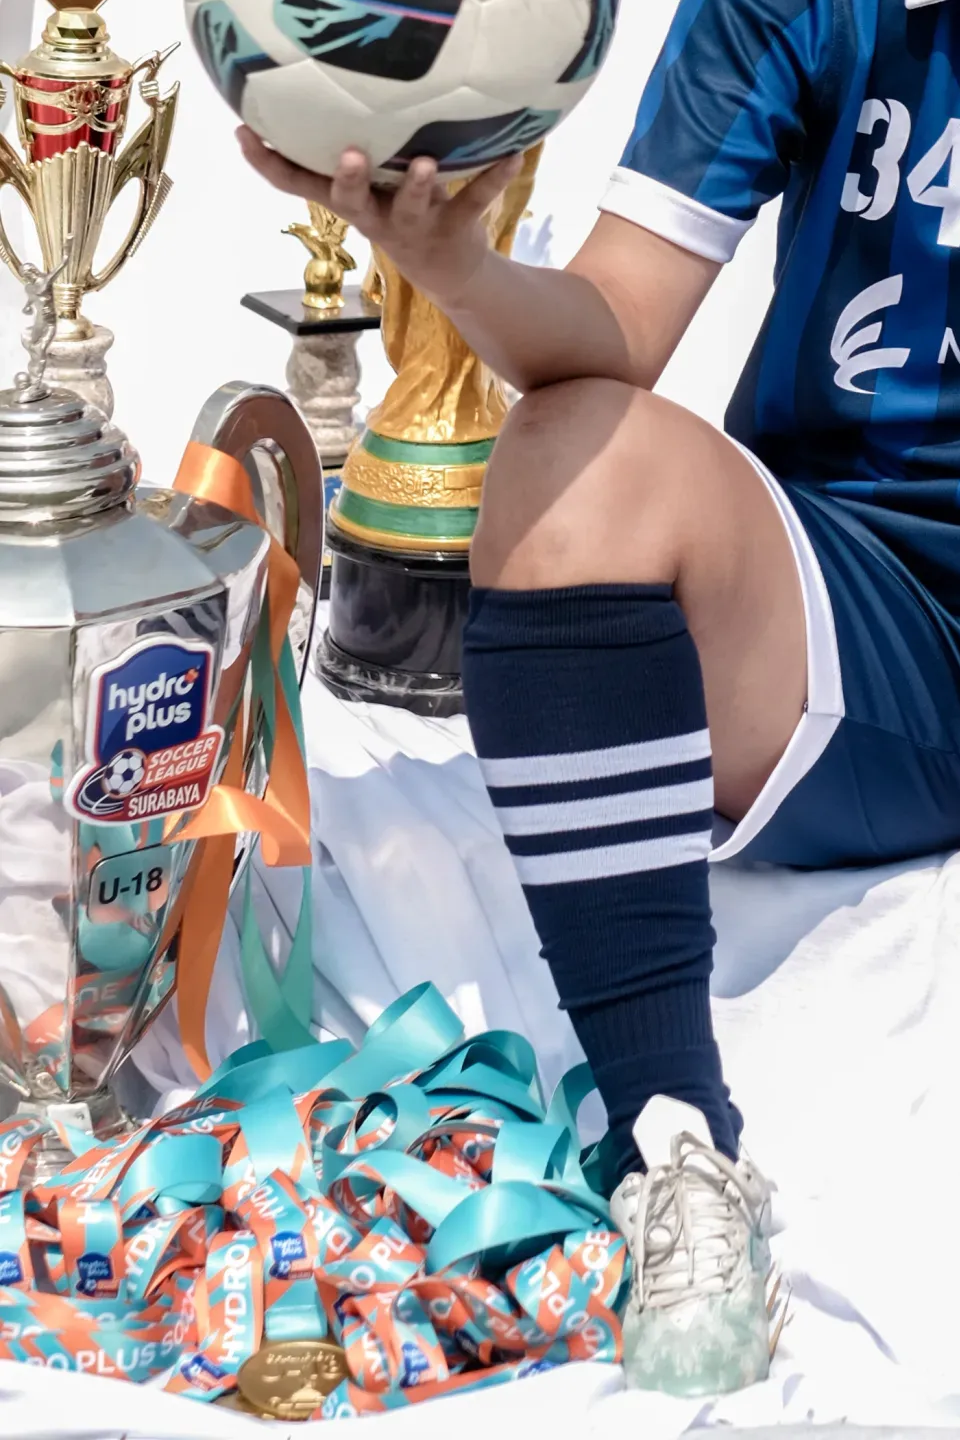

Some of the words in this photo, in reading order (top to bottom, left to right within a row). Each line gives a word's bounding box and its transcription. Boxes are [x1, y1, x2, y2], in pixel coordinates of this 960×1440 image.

[108, 672, 195, 715] hydro
[126, 701, 192, 741] plus
[144, 753, 209, 784] LEAGUE
[148, 736, 216, 769] SOCCER
[128, 782, 200, 818] SURABAYA
[98, 865, 163, 905] U-18
[216, 1244, 250, 1364] HYDRO
[76, 1341, 156, 1374] PLUS
